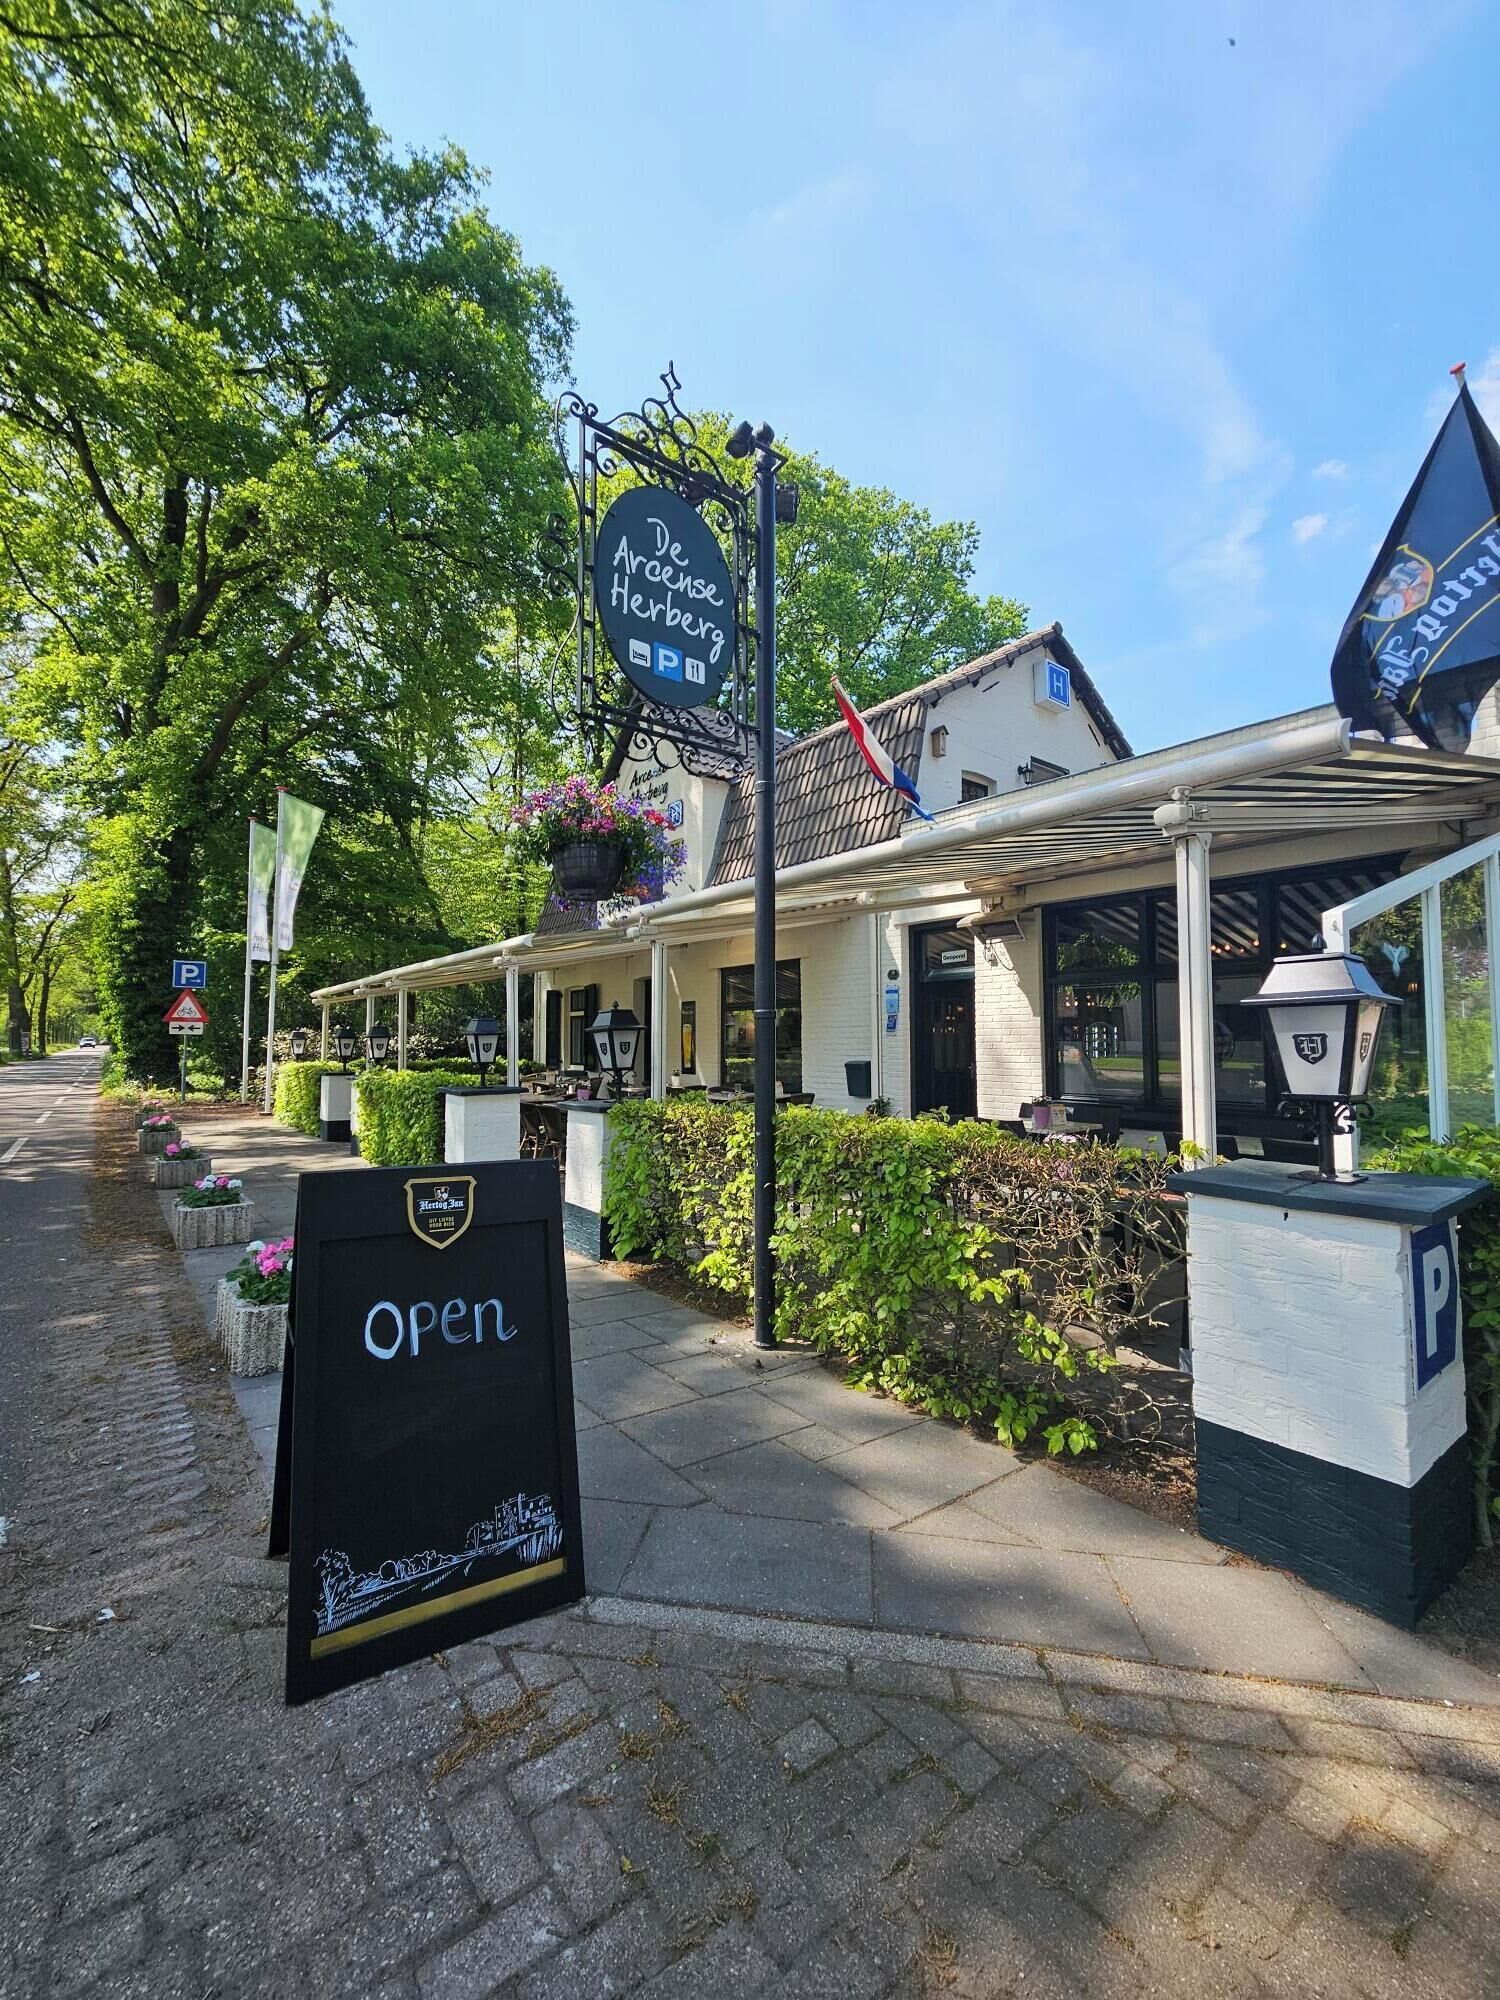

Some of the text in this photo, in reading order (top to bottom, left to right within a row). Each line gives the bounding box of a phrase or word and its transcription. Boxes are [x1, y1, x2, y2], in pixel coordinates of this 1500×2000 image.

[647, 518, 689, 566] De
[613, 535, 723, 606] Arcense
[610, 574, 725, 664] Herberg
[658, 647, 679, 672] P
[1053, 672, 1064, 697] H
[182, 965, 199, 984] P
[419, 1198, 463, 1212] Hertog Jan
[1423, 1244, 1451, 1360] P
